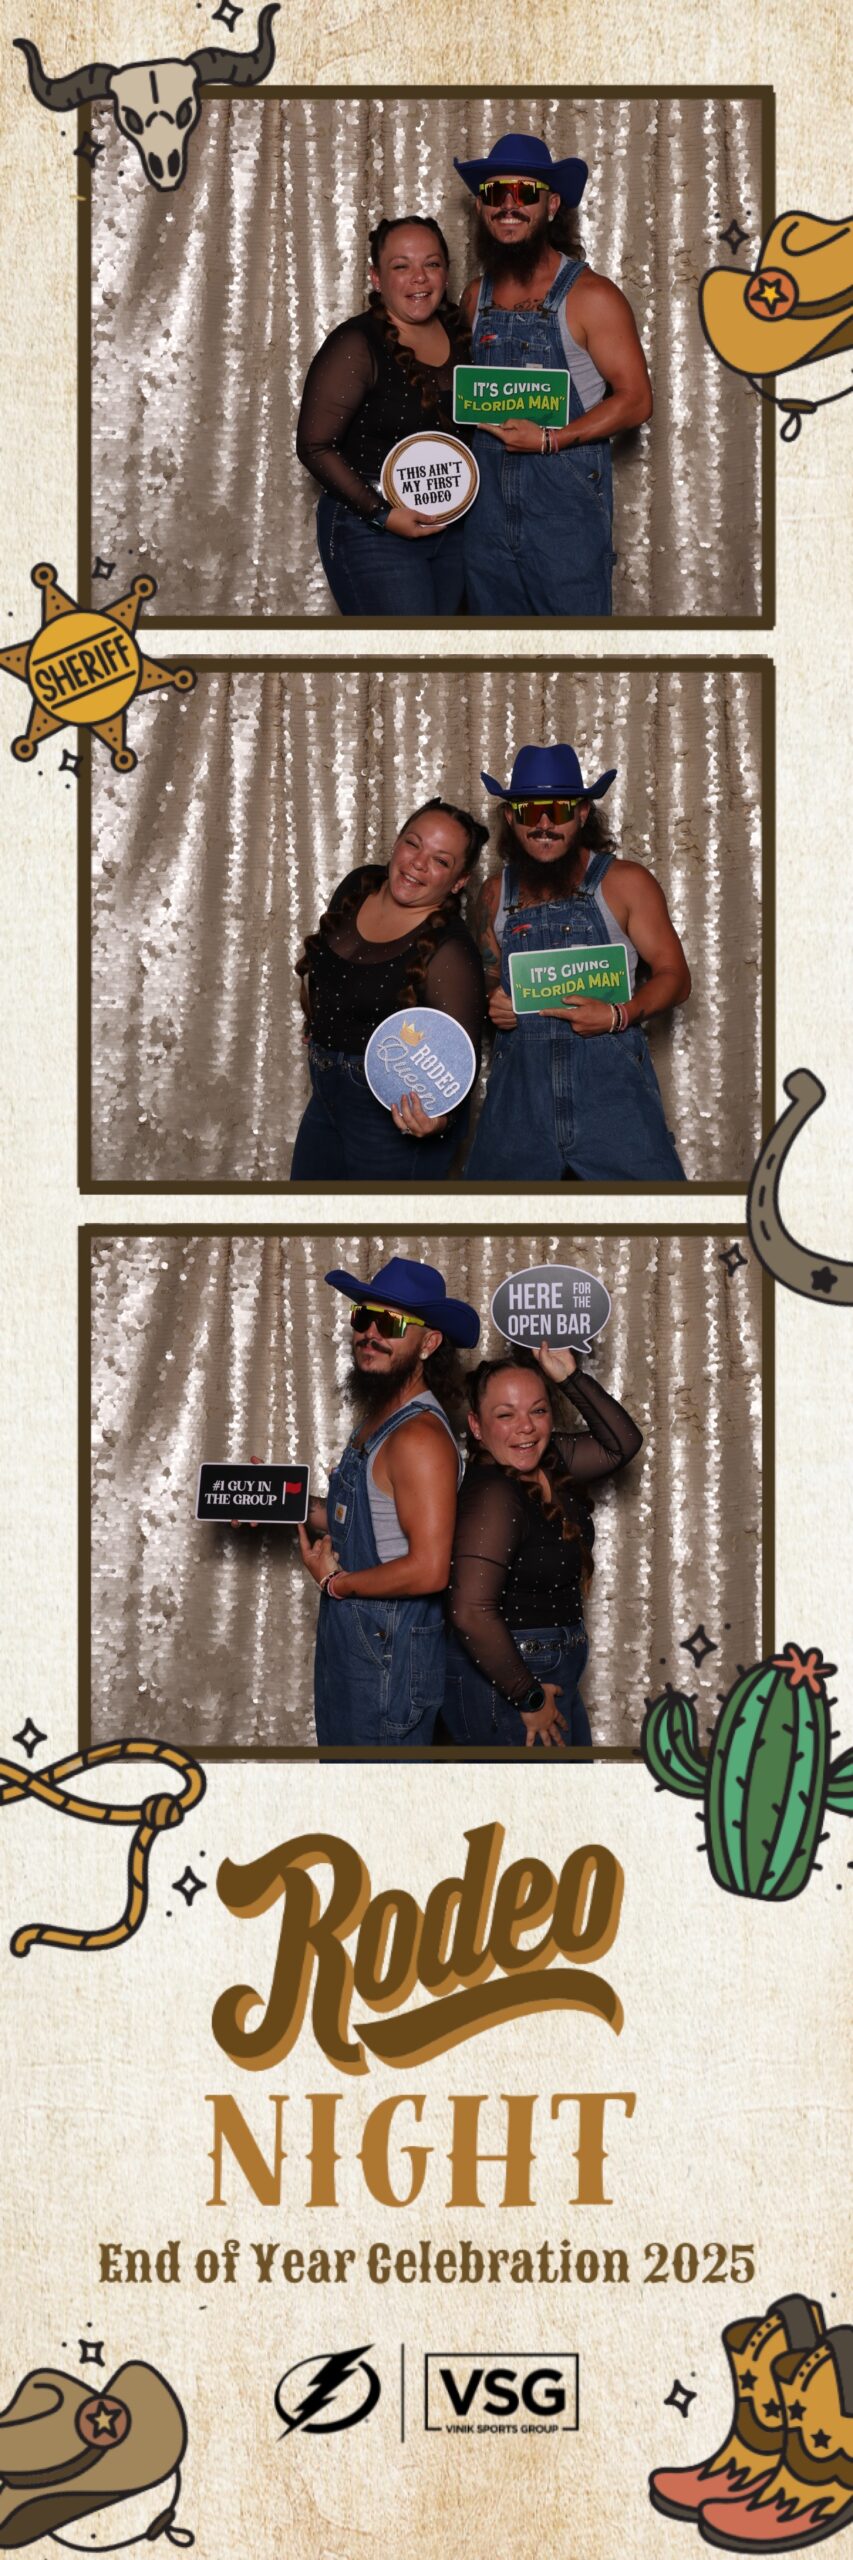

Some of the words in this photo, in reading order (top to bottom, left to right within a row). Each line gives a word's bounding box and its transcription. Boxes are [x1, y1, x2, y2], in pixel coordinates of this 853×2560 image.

[473, 381, 499, 398] IT'S
[503, 382, 551, 396] GIVING
[458, 395, 525, 412] "FLORIDA
[528, 395, 565, 411] MAN"
[396, 467, 427, 481] THIS
[428, 460, 463, 477] AIN'T
[402, 480, 420, 494] MY
[426, 475, 462, 489] FIRST
[414, 490, 451, 506] RODEO
[530, 966, 557, 983] IT'S
[561, 959, 610, 977] GIVING
[515, 979, 585, 999] "FLORIDA
[588, 971, 625, 987] MAN"
[375, 1034, 438, 1111] Queen
[410, 1043, 461, 1099] RODEO
[508, 1282, 563, 1310] HERE
[572, 1282, 591, 1295] FOR
[572, 1295, 591, 1308] THE
[507, 1313, 552, 1336] OPEN
[556, 1312, 591, 1335] BAR
[212, 1480, 225, 1491] #1
[227, 1481, 255, 1492] GUY
[258, 1480, 272, 1492] IN
[204, 1493, 231, 1505] THE
[232, 1493, 278, 1506] GROUP
